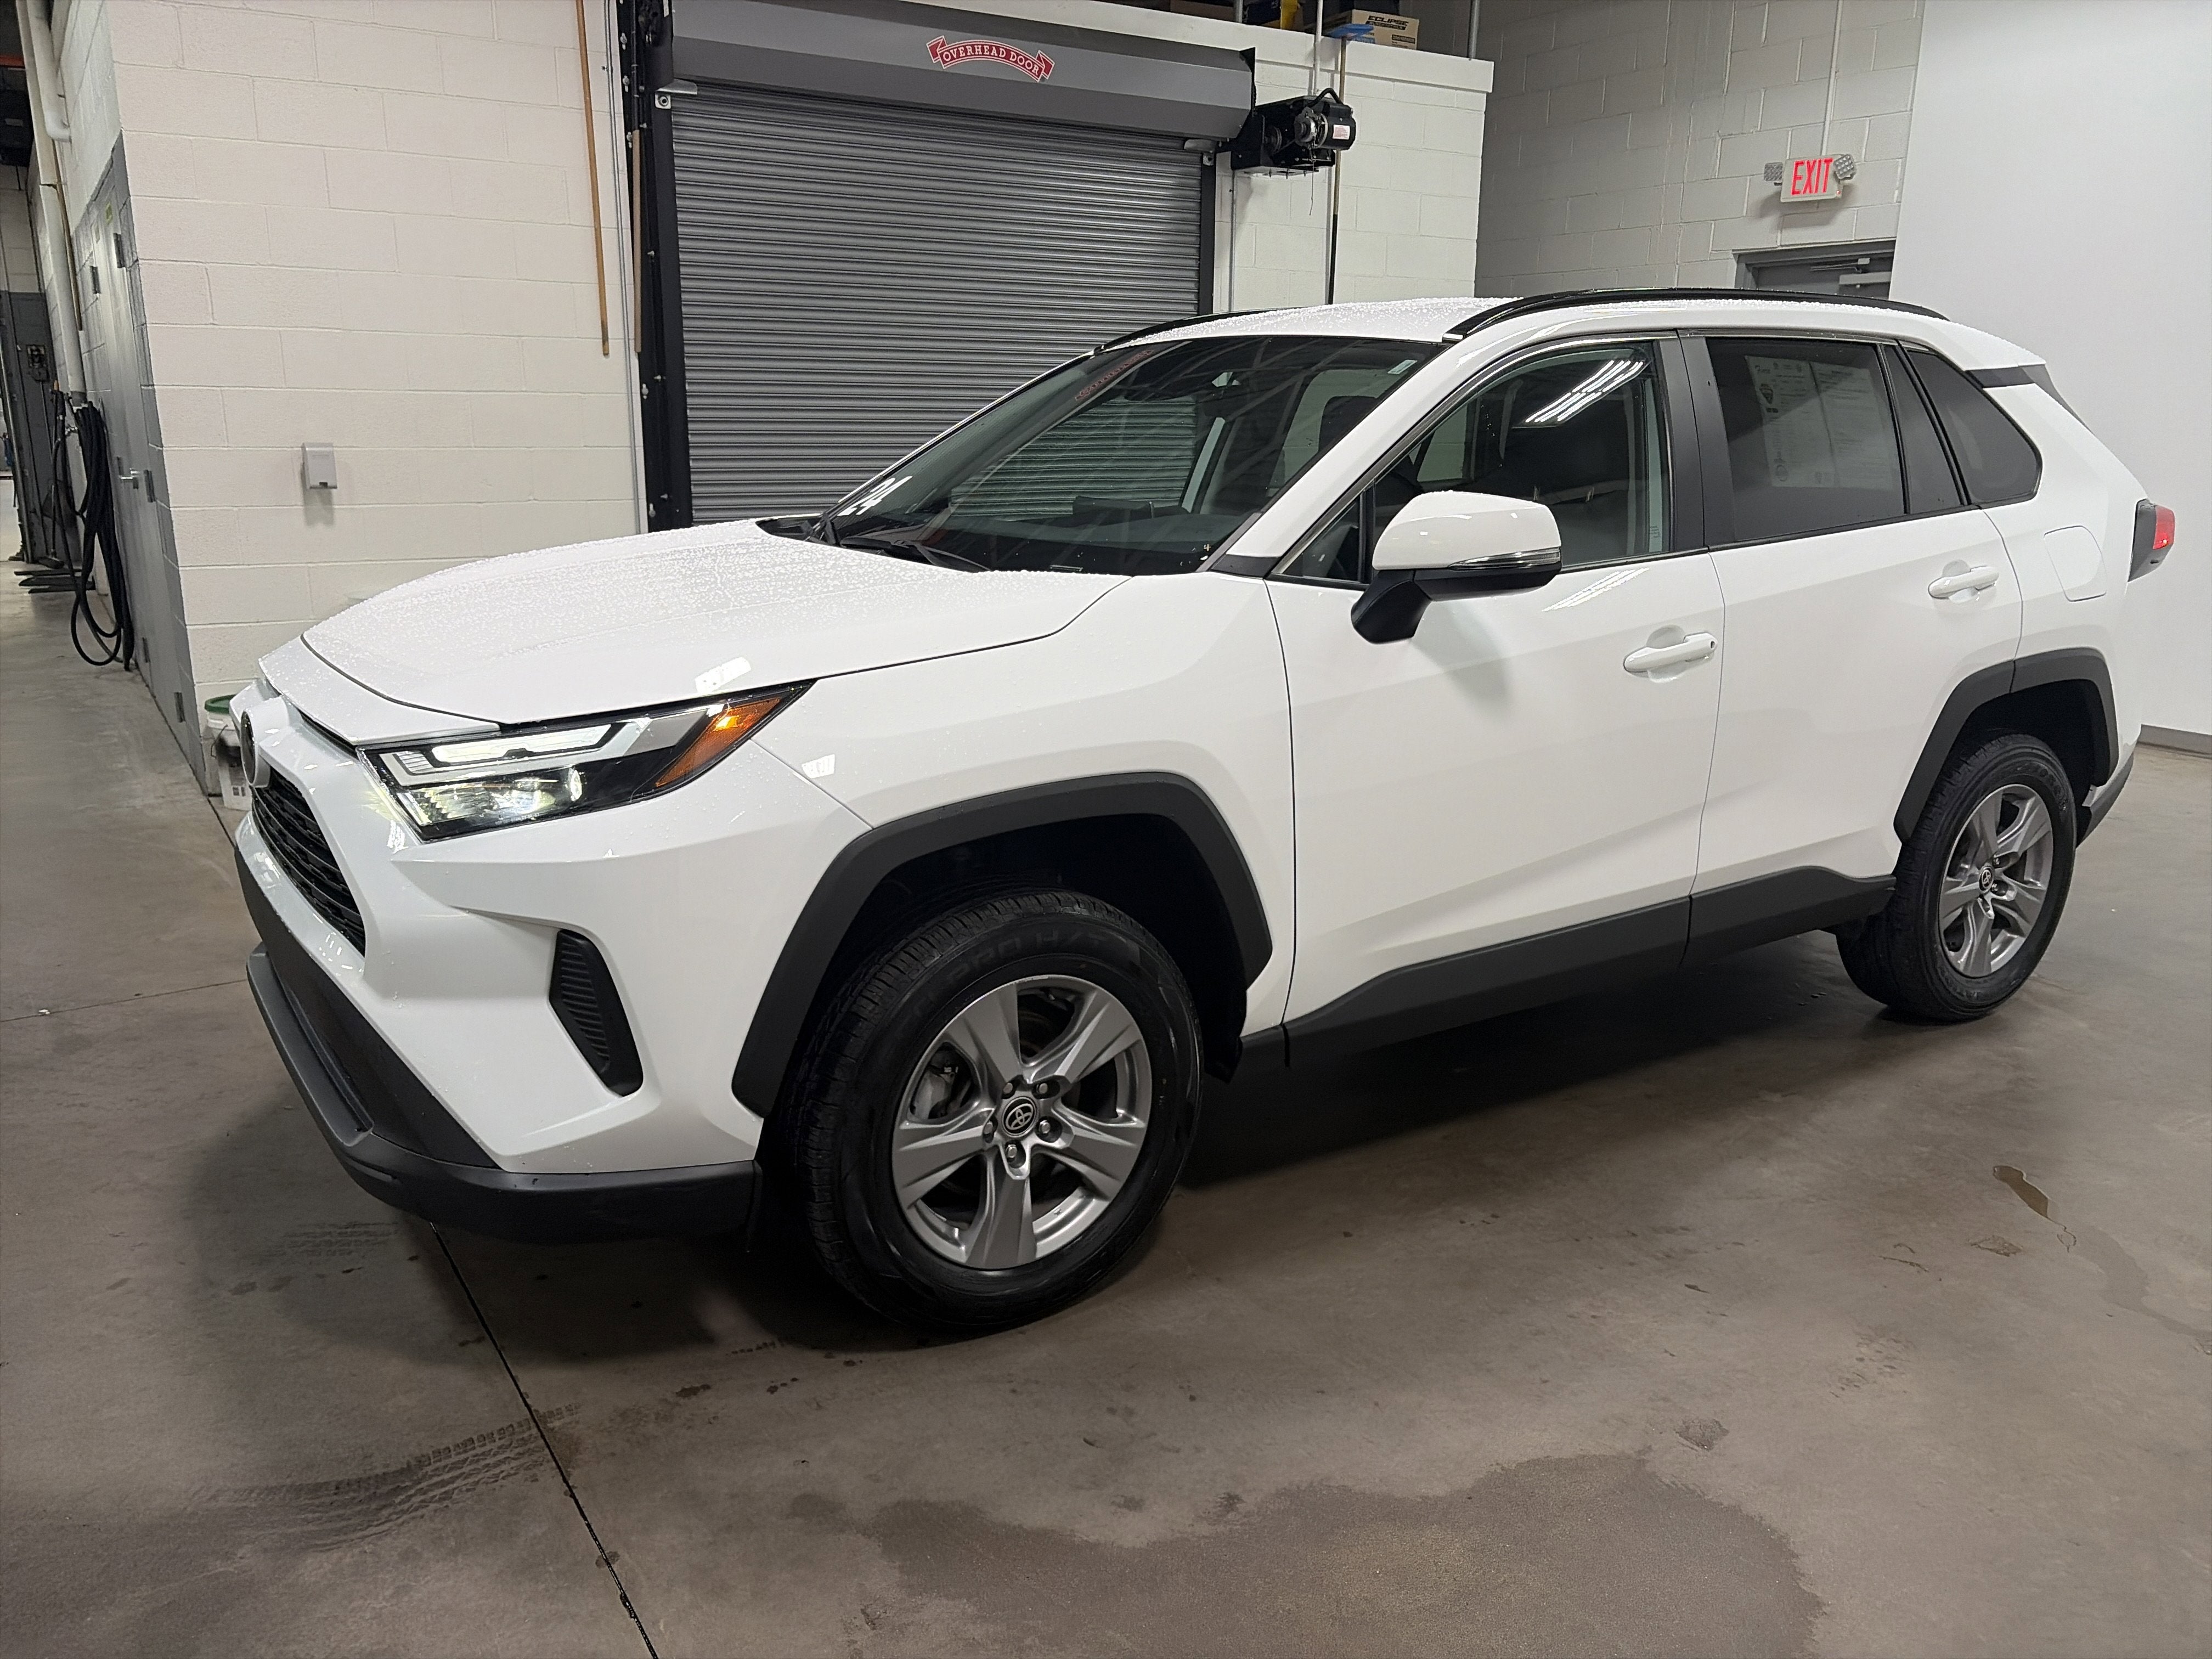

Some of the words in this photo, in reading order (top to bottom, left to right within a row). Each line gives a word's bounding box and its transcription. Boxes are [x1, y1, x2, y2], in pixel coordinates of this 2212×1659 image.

[1368, 15, 1408, 26] ECLIPSE
[943, 45, 1006, 62] OVERHEAD
[1009, 51, 1040, 76] DOOR
[1791, 158, 1833, 195] EXIT
[837, 476, 913, 516] 24
